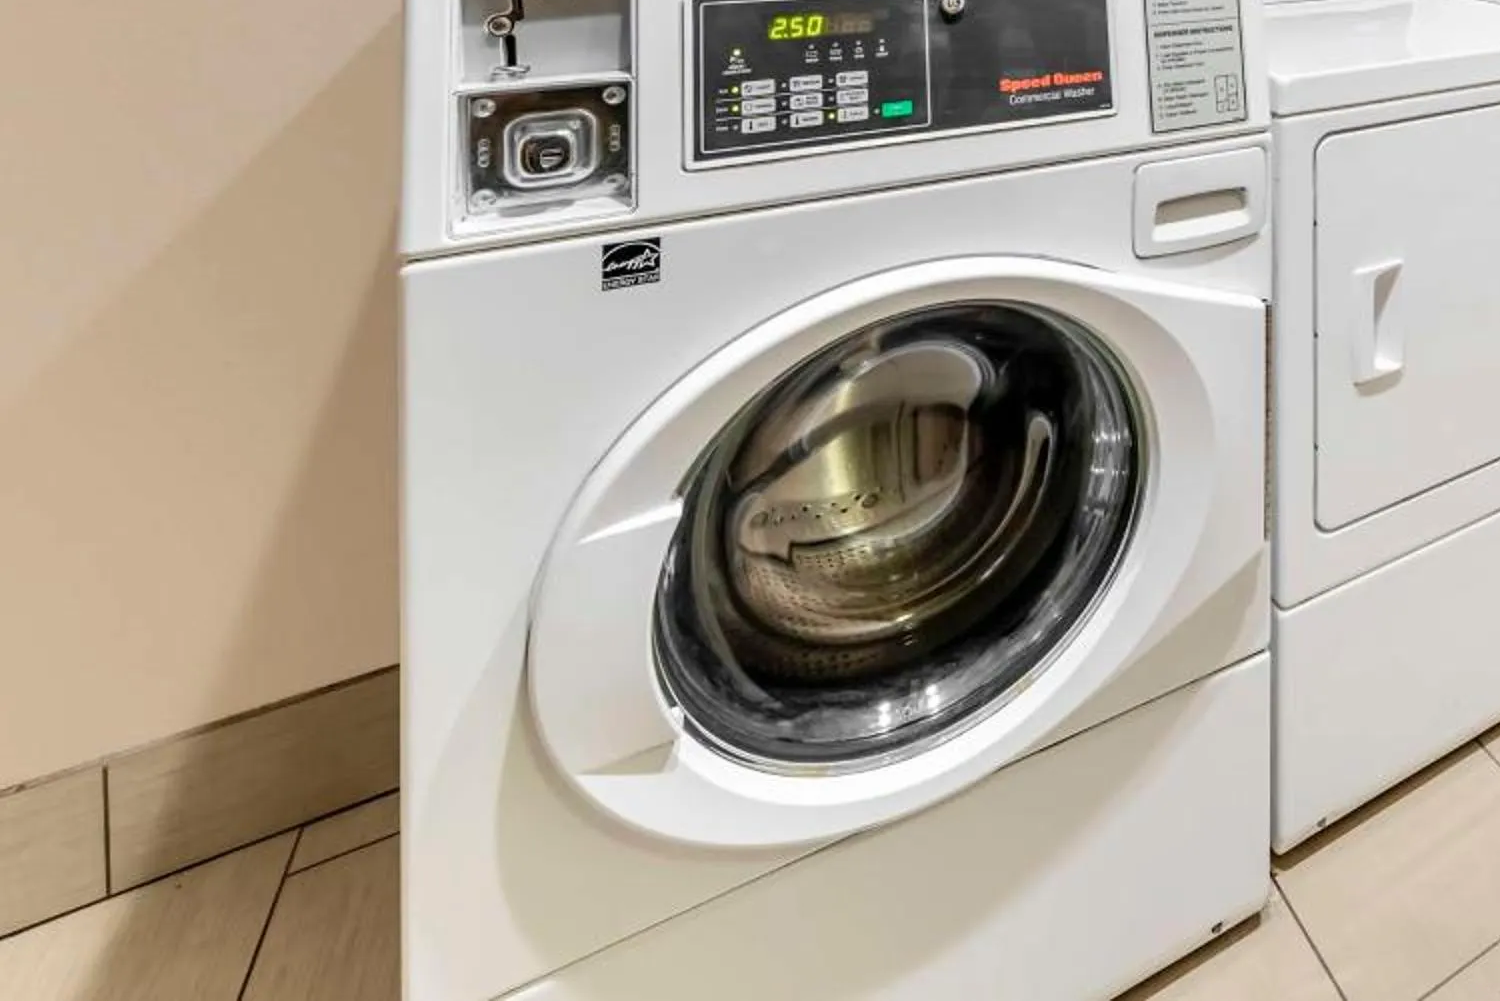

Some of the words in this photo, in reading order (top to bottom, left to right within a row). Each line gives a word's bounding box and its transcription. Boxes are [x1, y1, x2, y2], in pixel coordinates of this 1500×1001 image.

[768, 15, 824, 40] 2.50
[999, 74, 1051, 94] Speed
[1053, 71, 1104, 85] Queen
